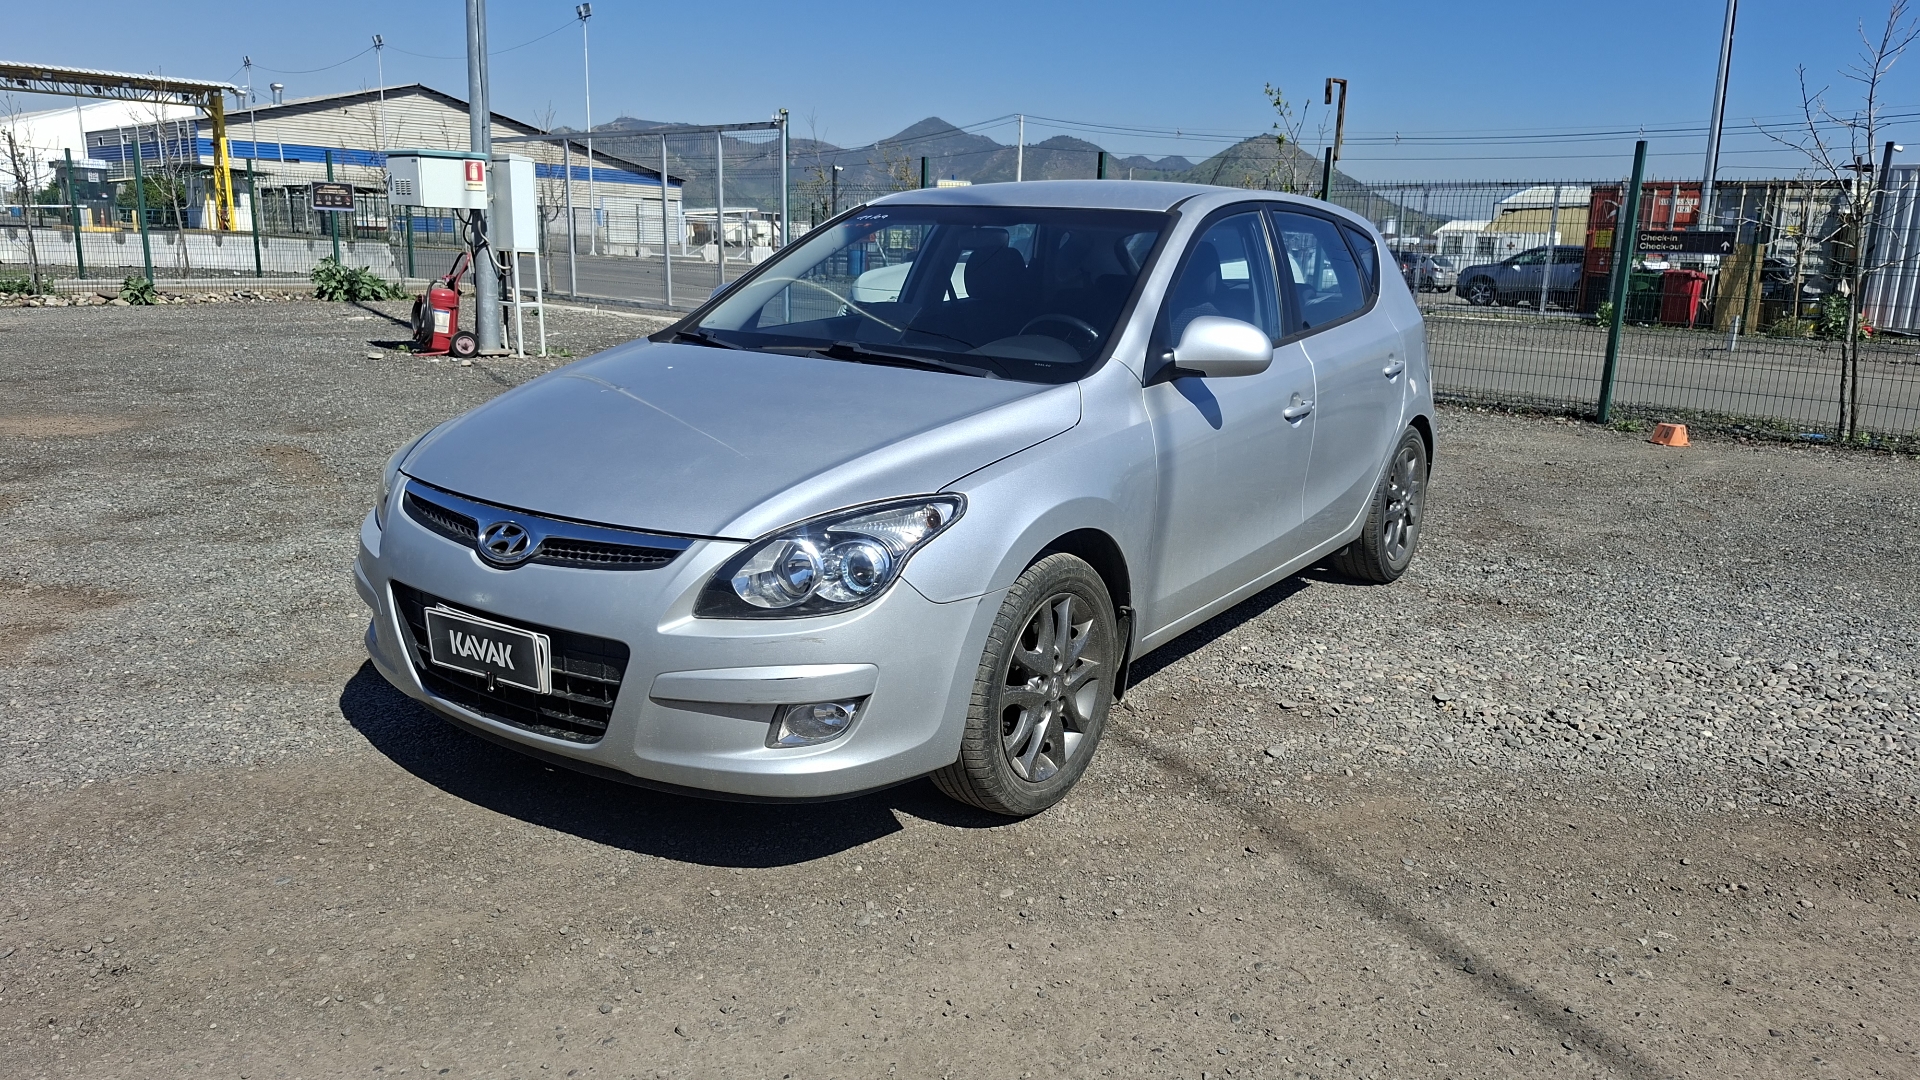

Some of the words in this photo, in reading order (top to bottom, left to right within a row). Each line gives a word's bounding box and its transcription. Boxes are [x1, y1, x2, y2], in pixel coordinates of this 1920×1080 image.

[1640, 233, 1678, 242] Check-in
[1639, 242, 1683, 250] Check-out
[449, 629, 515, 670] KAVAK
